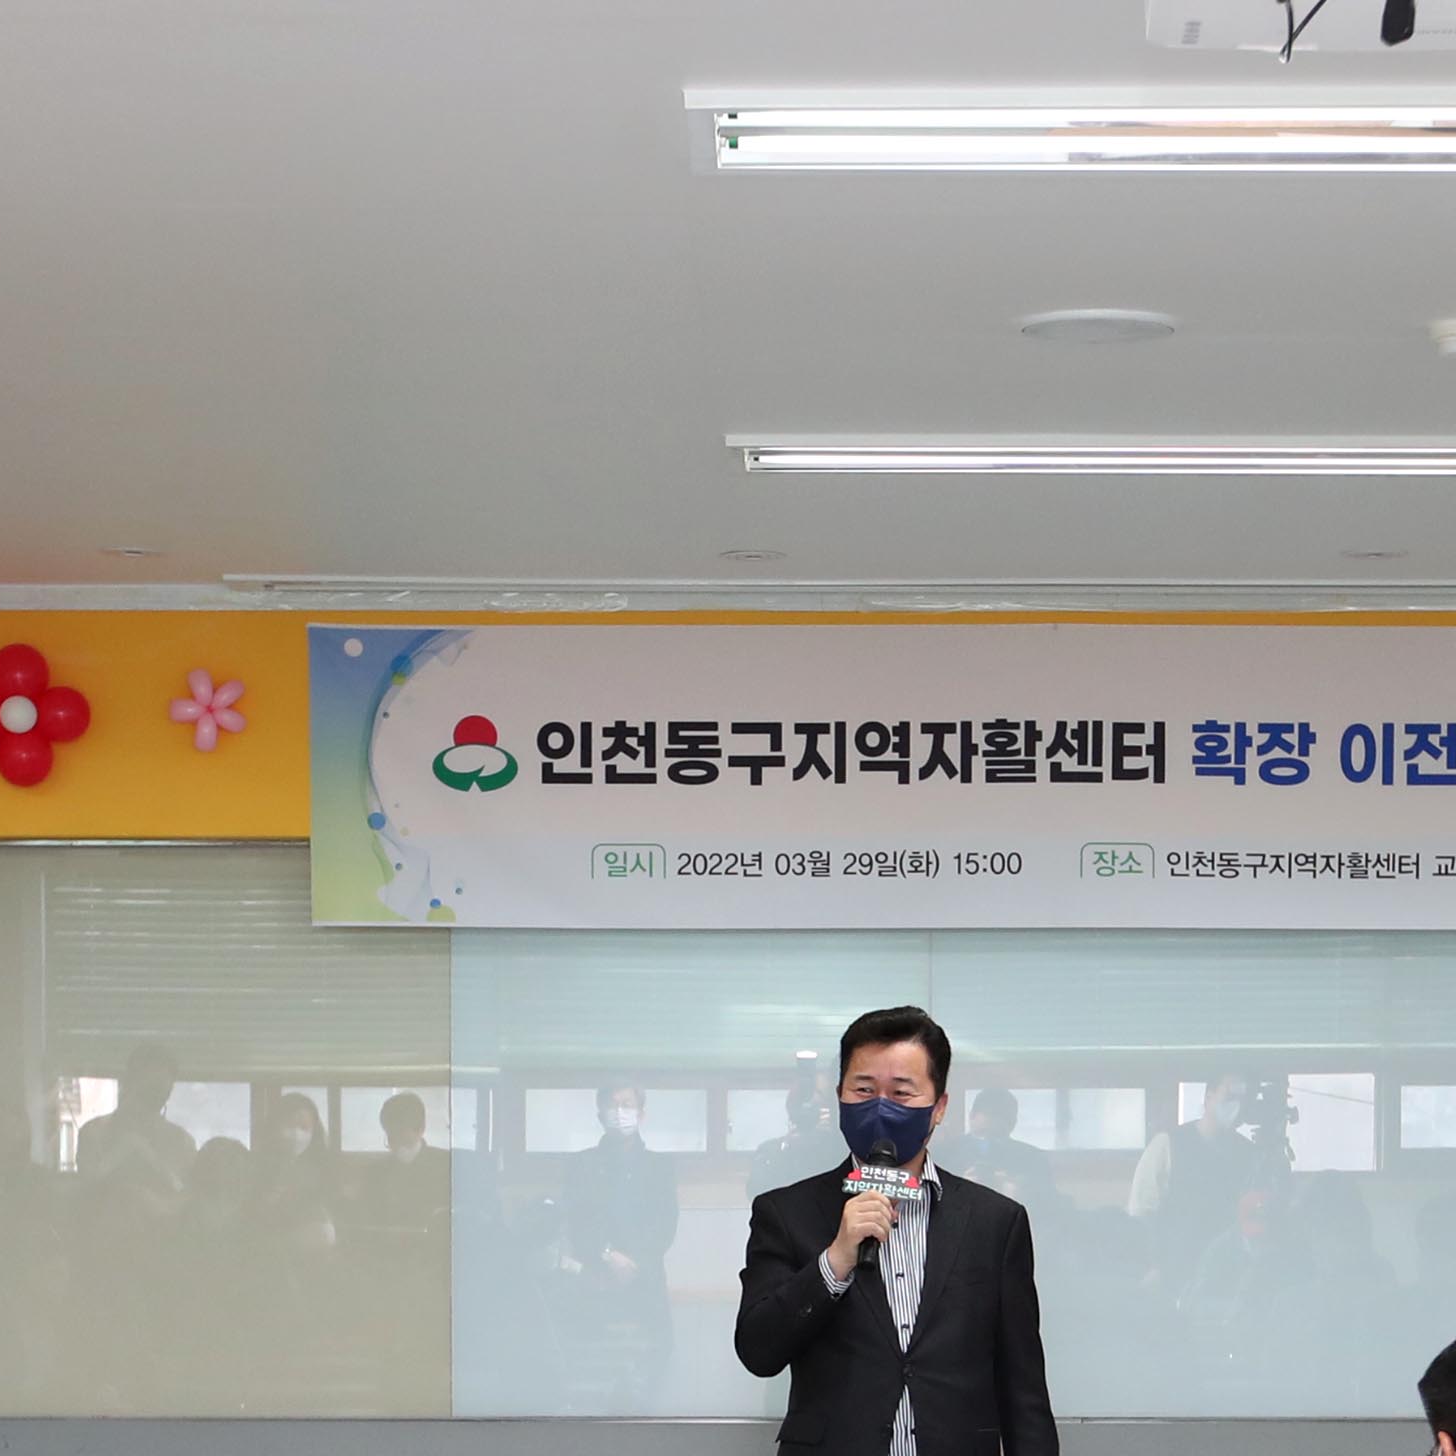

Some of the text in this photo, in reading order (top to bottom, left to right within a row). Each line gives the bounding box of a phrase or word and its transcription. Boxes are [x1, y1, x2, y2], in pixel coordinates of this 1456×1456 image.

[537, 719, 1166, 786] 인천동구지역자활센터
[1191, 719, 1317, 786] 확장
[603, 849, 1023, 879] 일시 2022년 03월 29일(화) 15:00
[1092, 849, 1144, 877] 장소
[1166, 850, 1420, 880] 인천동구지역자활센터
[860, 1166, 910, 1184] 인천동구
